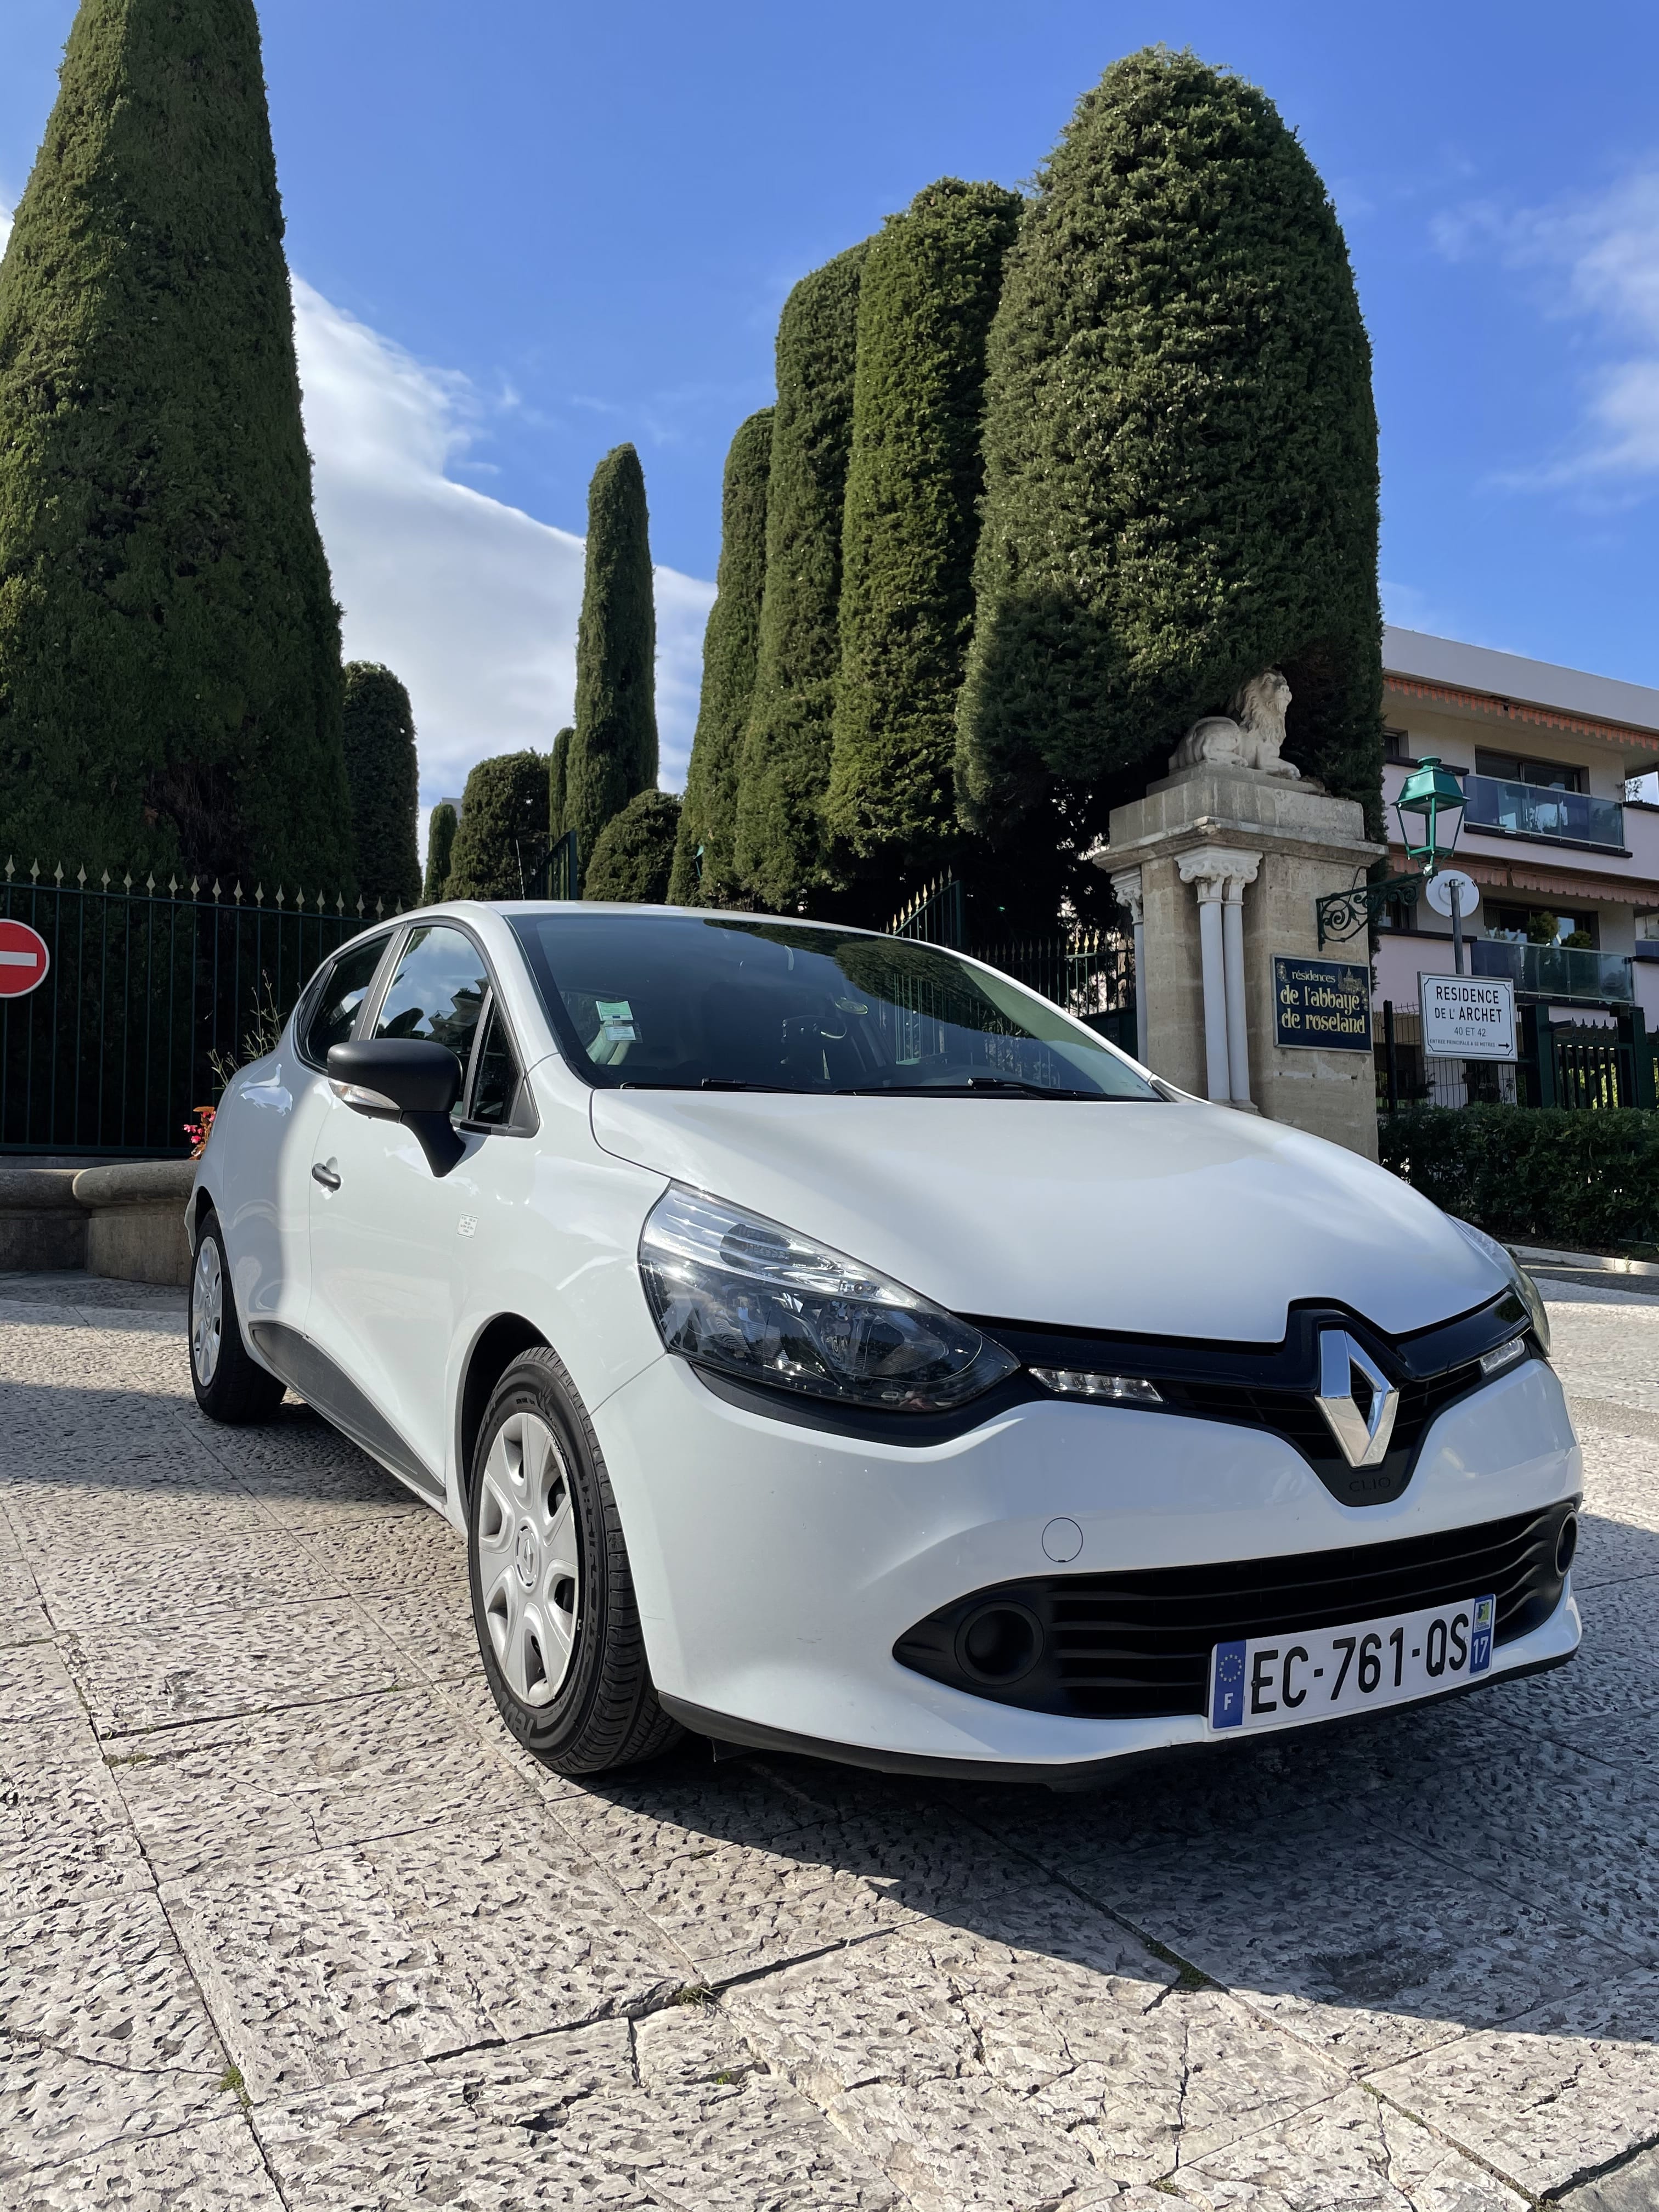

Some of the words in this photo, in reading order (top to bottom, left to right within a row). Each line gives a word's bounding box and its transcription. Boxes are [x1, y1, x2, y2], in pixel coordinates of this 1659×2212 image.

[1292, 970, 1336, 983] résidences
[1280, 985, 1299, 1005] de
[1305, 986, 1359, 1015] l'abbaye
[1436, 986, 1499, 1004] RESIDENCE
[1282, 1008, 1301, 1029] de
[1306, 1013, 1365, 1034] roseland
[1435, 1007, 1446, 1019] DE
[1454, 1027, 1463, 1036] 40
[1465, 1027, 1475, 1036] ET
[1477, 1028, 1486, 1037] 42
[1350, 1477, 1390, 1492] CLIO
[1474, 1636, 1489, 1664] 17
[1251, 1613, 1469, 1715] EC-761-QS
[1224, 1692, 1234, 1710] F
